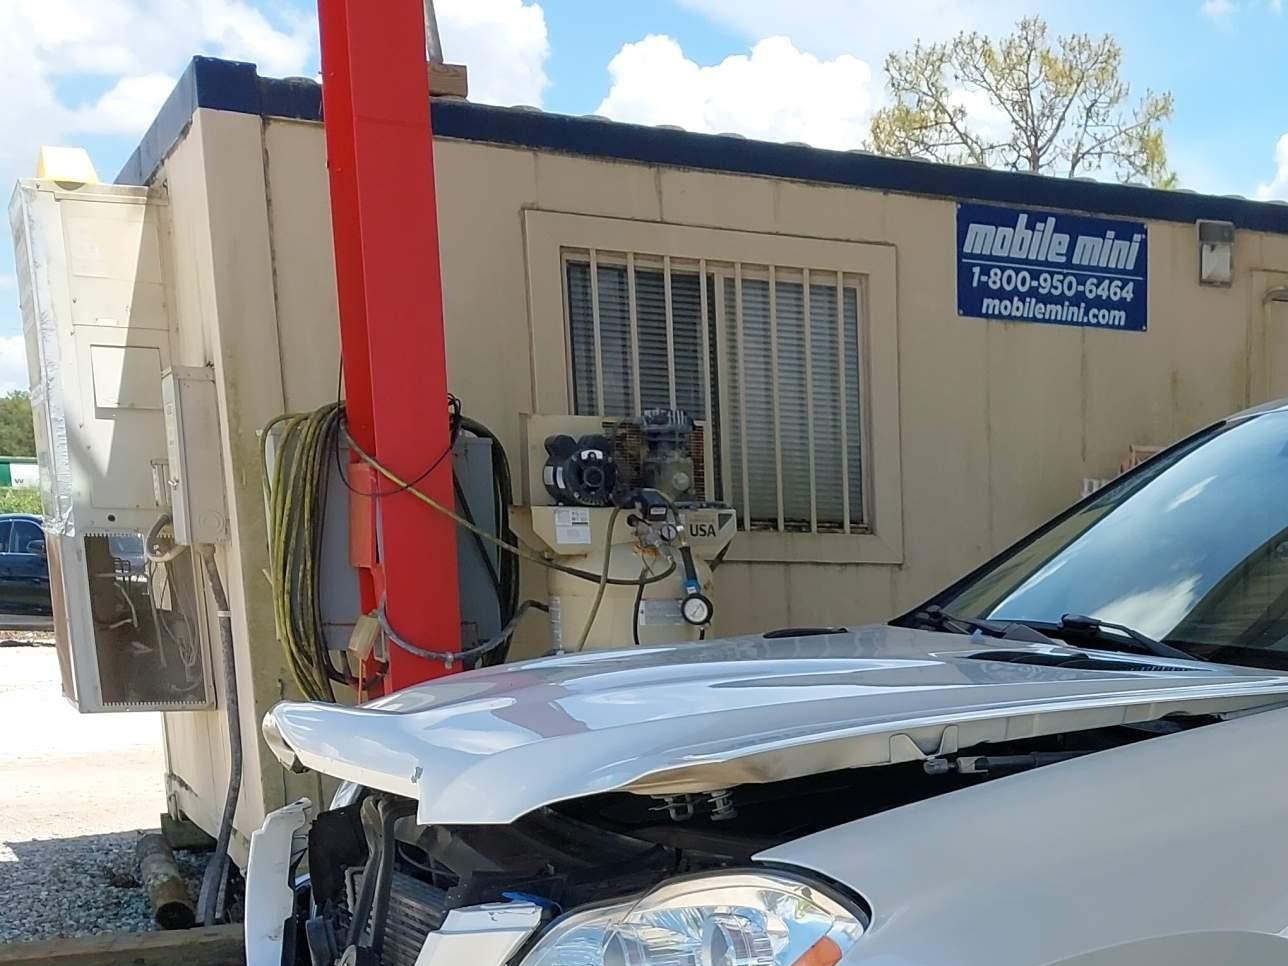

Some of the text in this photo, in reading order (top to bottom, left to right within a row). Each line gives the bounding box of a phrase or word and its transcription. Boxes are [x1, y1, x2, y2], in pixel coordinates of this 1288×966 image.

[962, 213, 1142, 270] mobile mini
[971, 266, 1134, 302] 1-800-950-6464
[981, 296, 1126, 326] mobilemini.com
[689, 523, 716, 537] USA
